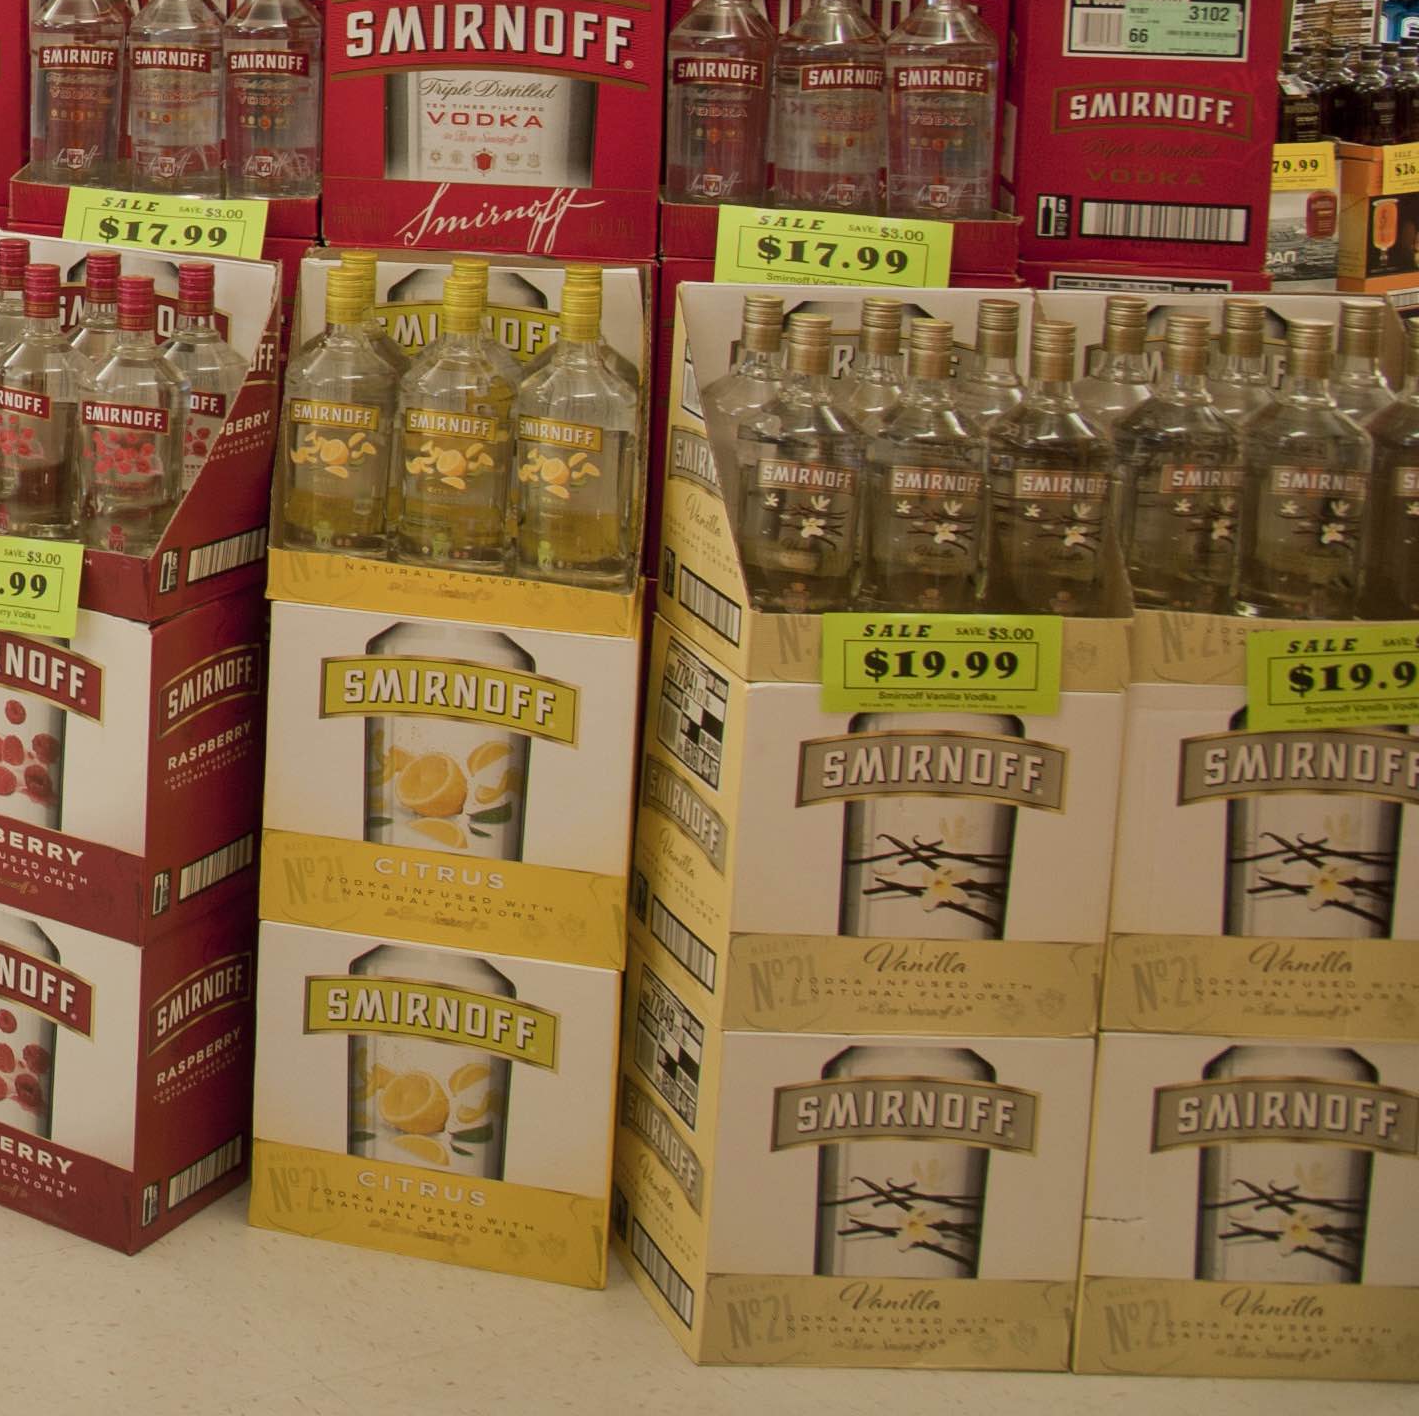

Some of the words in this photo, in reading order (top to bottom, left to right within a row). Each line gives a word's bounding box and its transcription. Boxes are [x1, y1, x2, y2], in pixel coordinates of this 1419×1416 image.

[1189, 6, 1230, 22] 3102
[345, 4, 634, 65] SMIRNOFF
[863, 646, 1019, 680] $19.99
[374, 857, 505, 890] CITRUS
[863, 942, 968, 976] Vanilla
